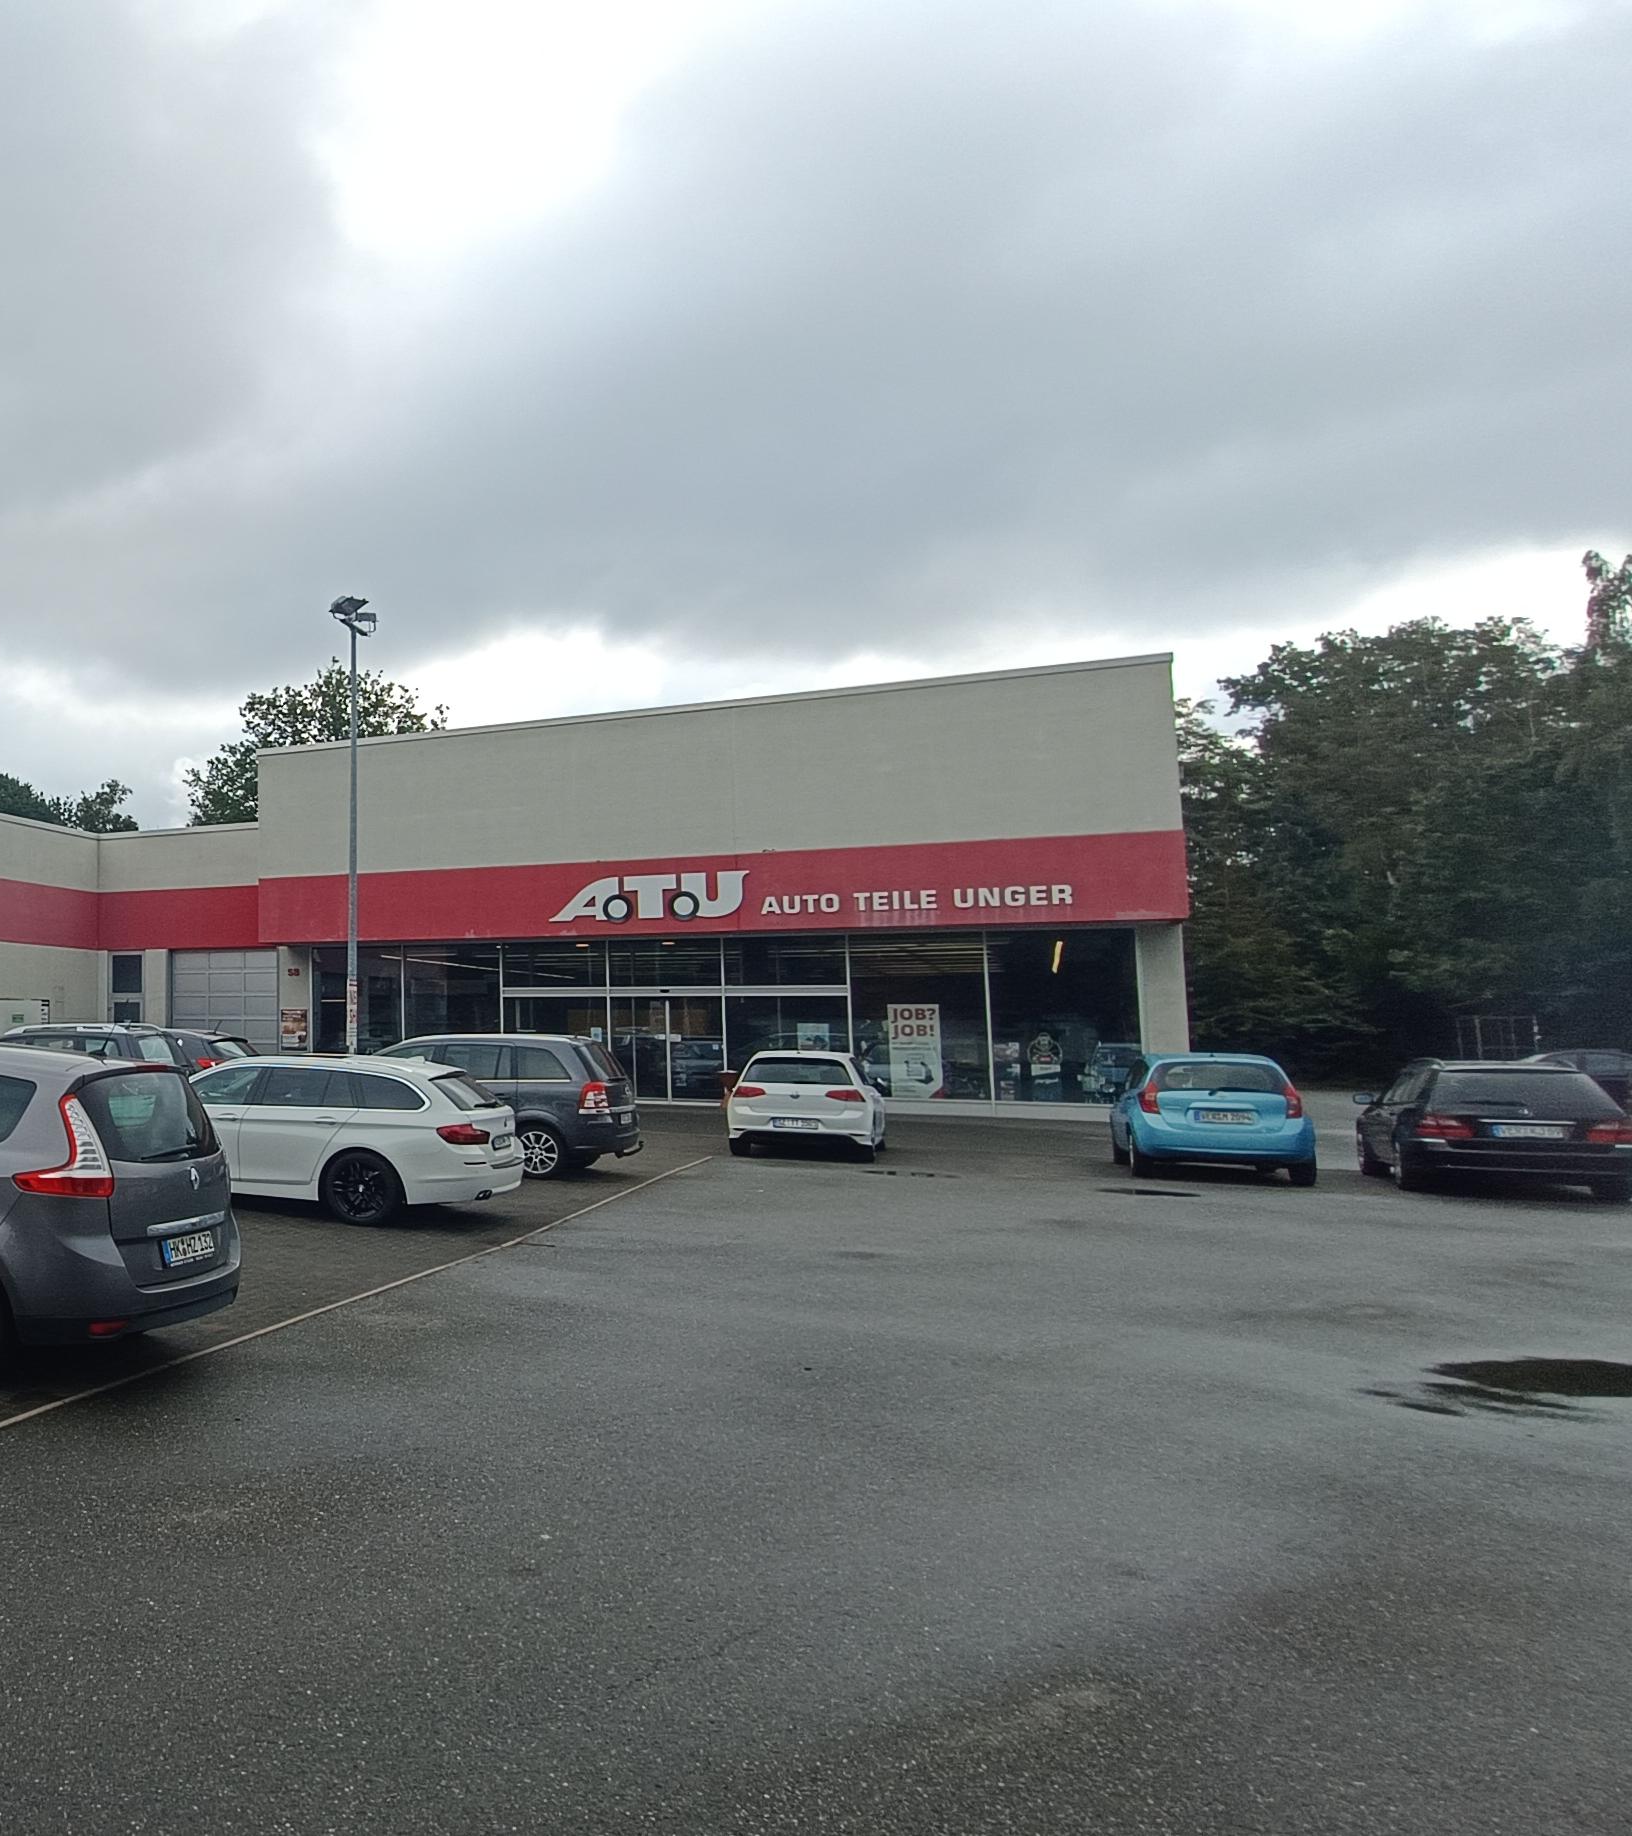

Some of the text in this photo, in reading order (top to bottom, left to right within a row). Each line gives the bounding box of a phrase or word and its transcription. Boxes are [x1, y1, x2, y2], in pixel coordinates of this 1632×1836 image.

[761, 884, 1073, 914] AUTO TEILE UNGER
[891, 1007, 936, 1024] JOB?
[891, 1024, 934, 1040] JOB!
[169, 1239, 183, 1258] HK
[198, 1233, 214, 1251] 132
